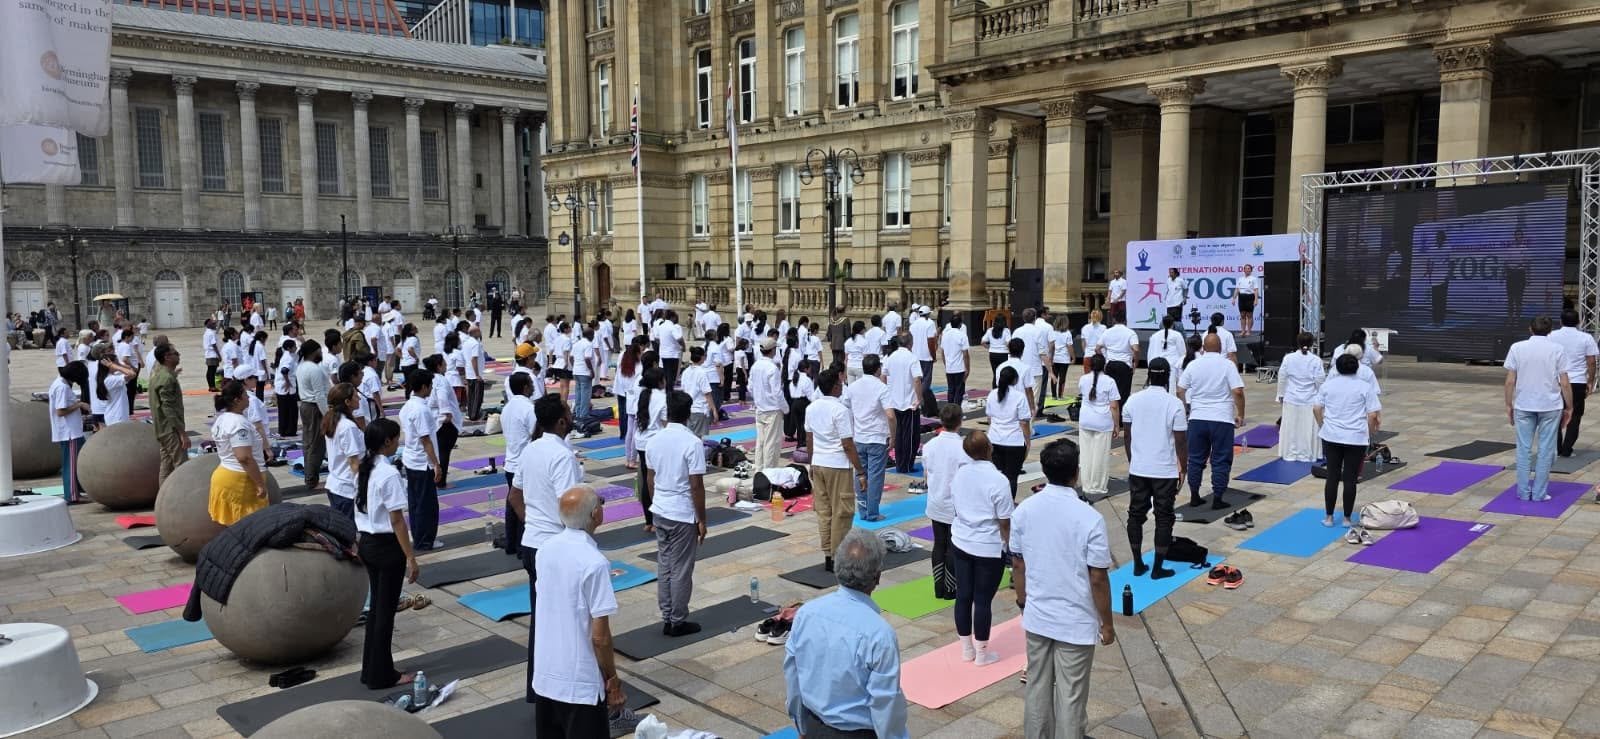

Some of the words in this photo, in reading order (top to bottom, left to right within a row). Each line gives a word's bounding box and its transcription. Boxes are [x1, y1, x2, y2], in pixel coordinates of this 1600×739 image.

[80, 7, 91, 15] in
[95, 8, 110, 17] the
[54, 16, 66, 25] of
